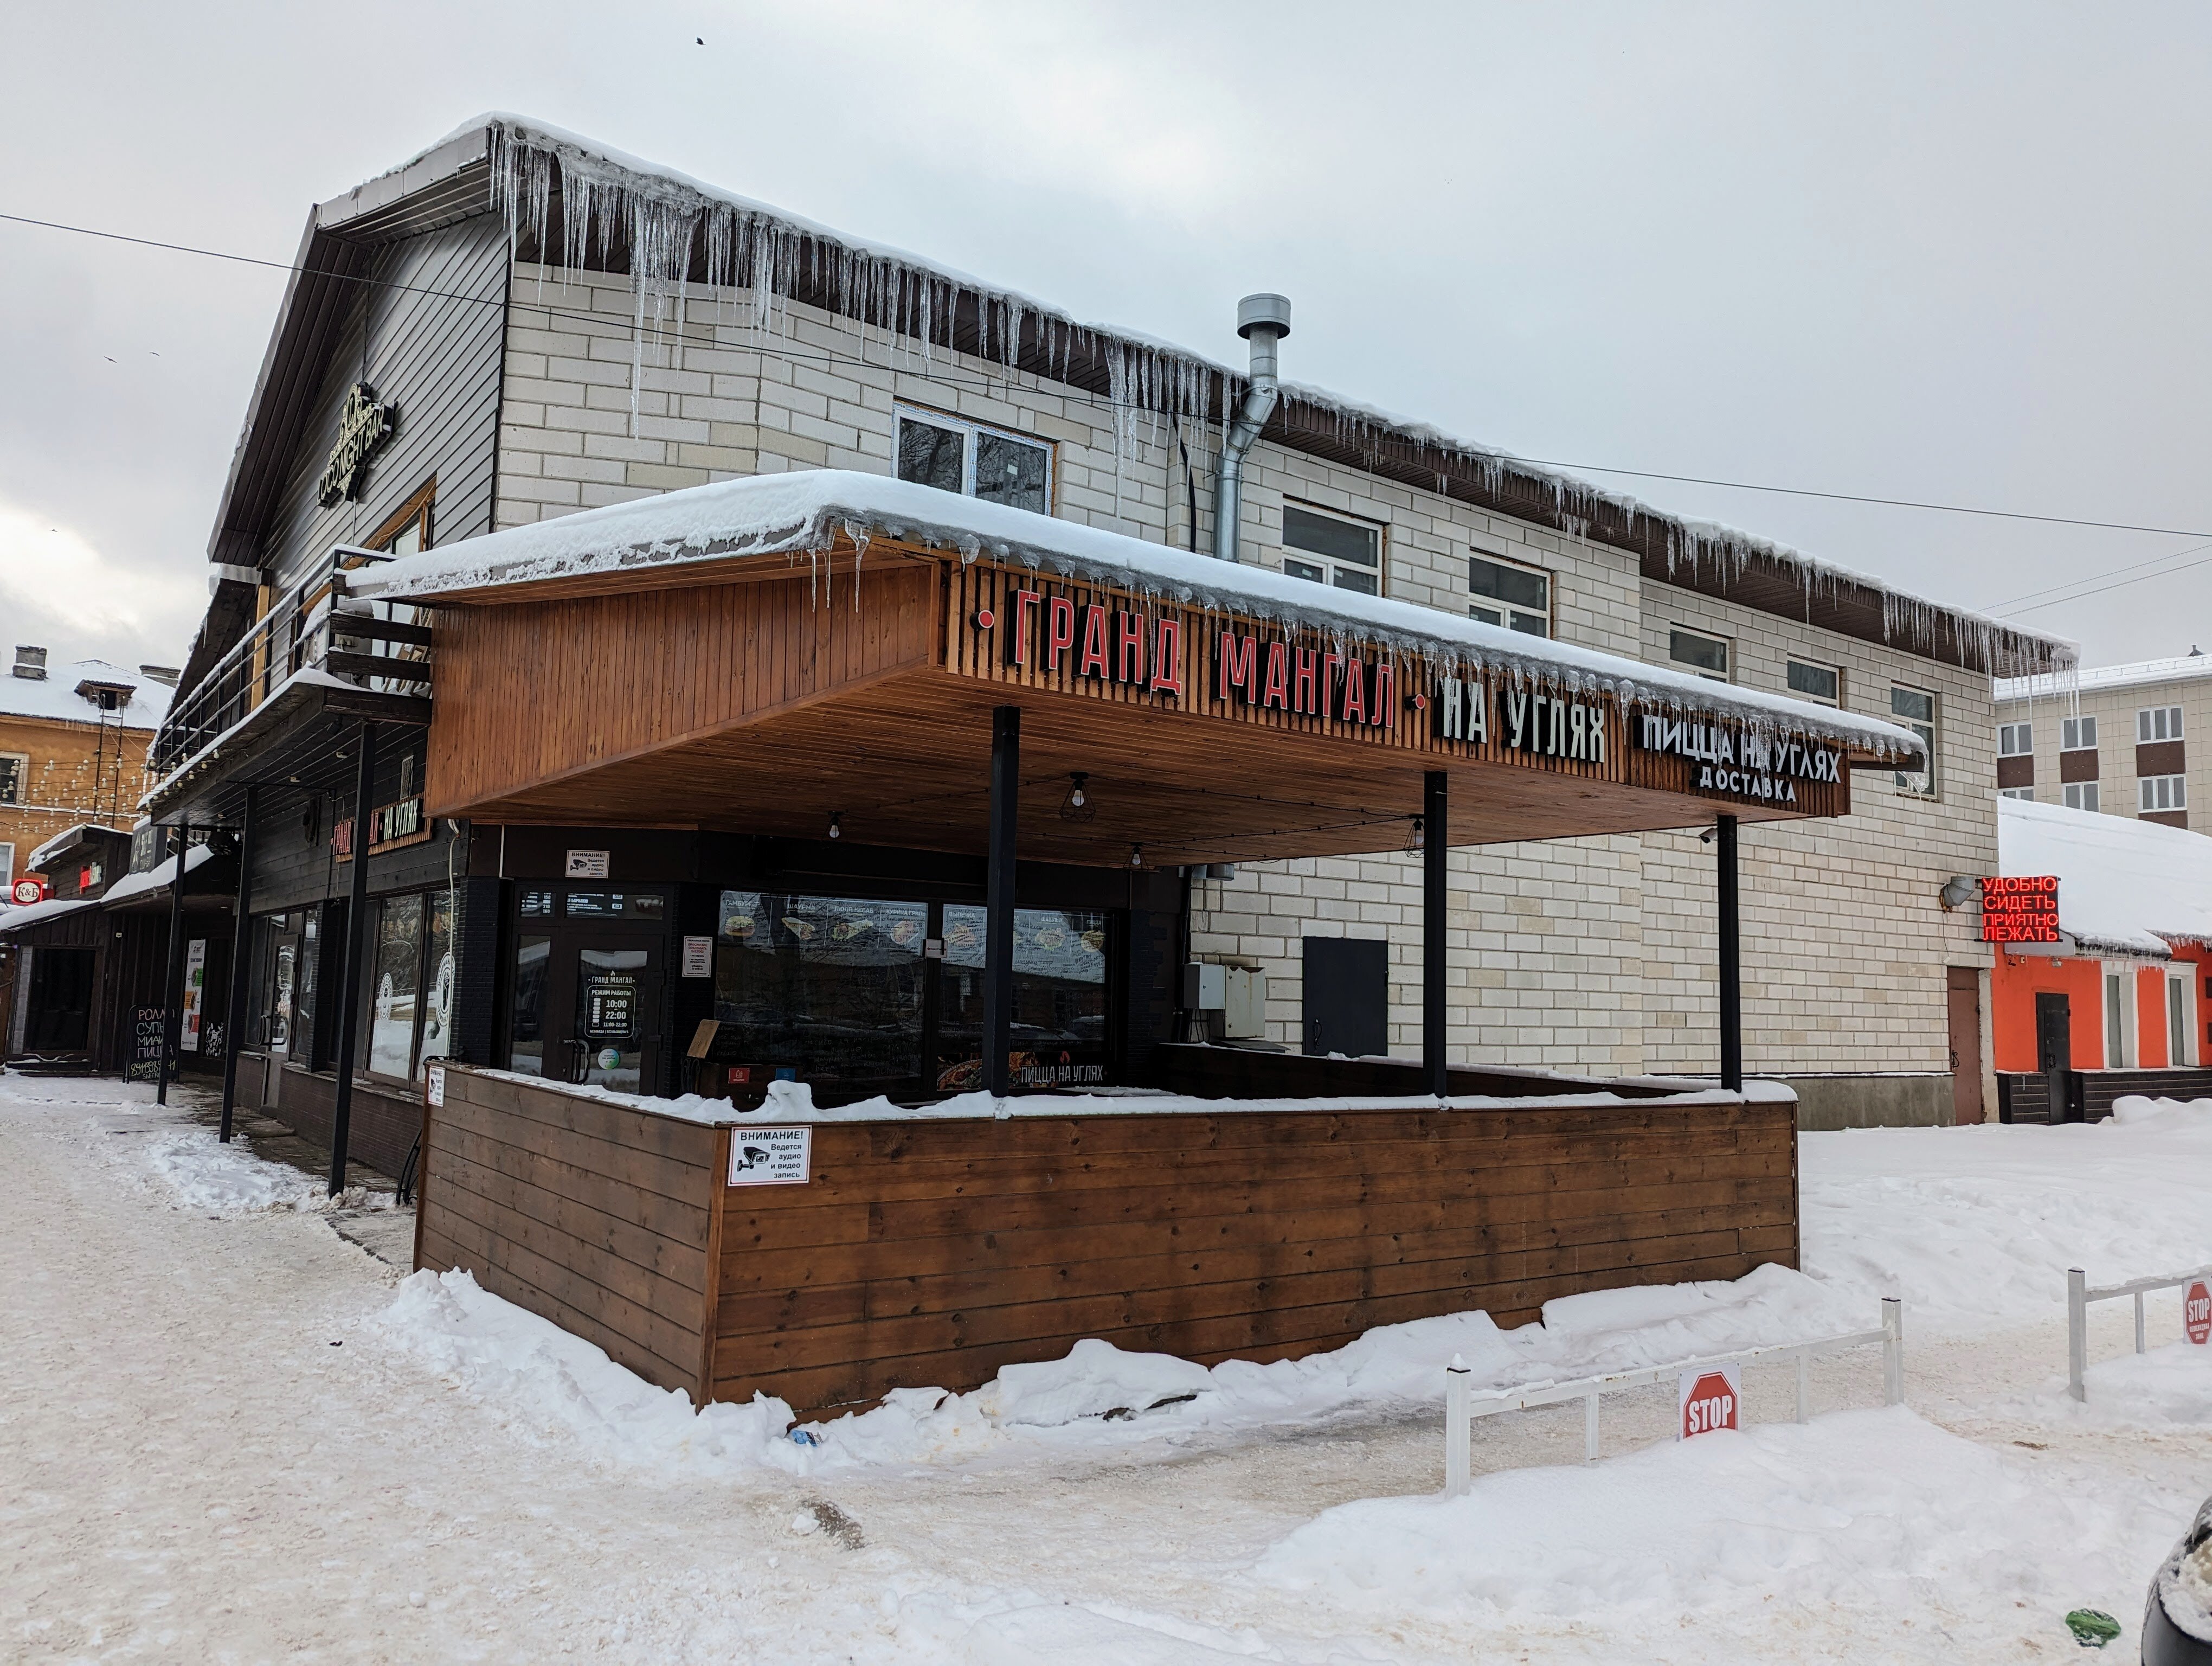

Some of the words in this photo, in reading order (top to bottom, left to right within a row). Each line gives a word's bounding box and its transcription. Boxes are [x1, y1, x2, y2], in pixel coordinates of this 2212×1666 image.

[365, 403, 384, 451] BAR
[1015, 589, 1181, 696] ГРАНД
[1219, 631, 1394, 728] МАНГАЛ
[1443, 676, 1488, 744] НА
[1510, 690, 1605, 763] УГЛЯХ
[1643, 714, 1734, 764] ПИЦЦА
[1776, 739, 1841, 784] УГЛЯХ
[1700, 766, 1797, 803] ДОСТАВКА
[383, 806, 394, 841] НА
[395, 798, 419, 837] УГЛЯХ
[332, 821, 351, 855] ГРАНД
[17, 887, 38, 898] К&Б
[1982, 876, 2057, 895] УДОБНО
[1984, 895, 2056, 913] СИДЕТЬ
[1983, 913, 2059, 926] ПРИЯТНО
[1983, 926, 2058, 941] ЛЕЖАТЬ
[606, 999, 627, 1008] 10:00
[605, 1011, 627, 1020] 22:00
[1021, 1066, 1056, 1084] ПИЦЦА
[1058, 1066, 1071, 1082] НА
[1073, 1065, 1103, 1082] УГЛЯХ
[741, 1131, 803, 1140] ВНИМАНИЕ!
[2188, 1298, 2210, 1323] STOP
[1689, 1395, 1732, 1433] STOP
